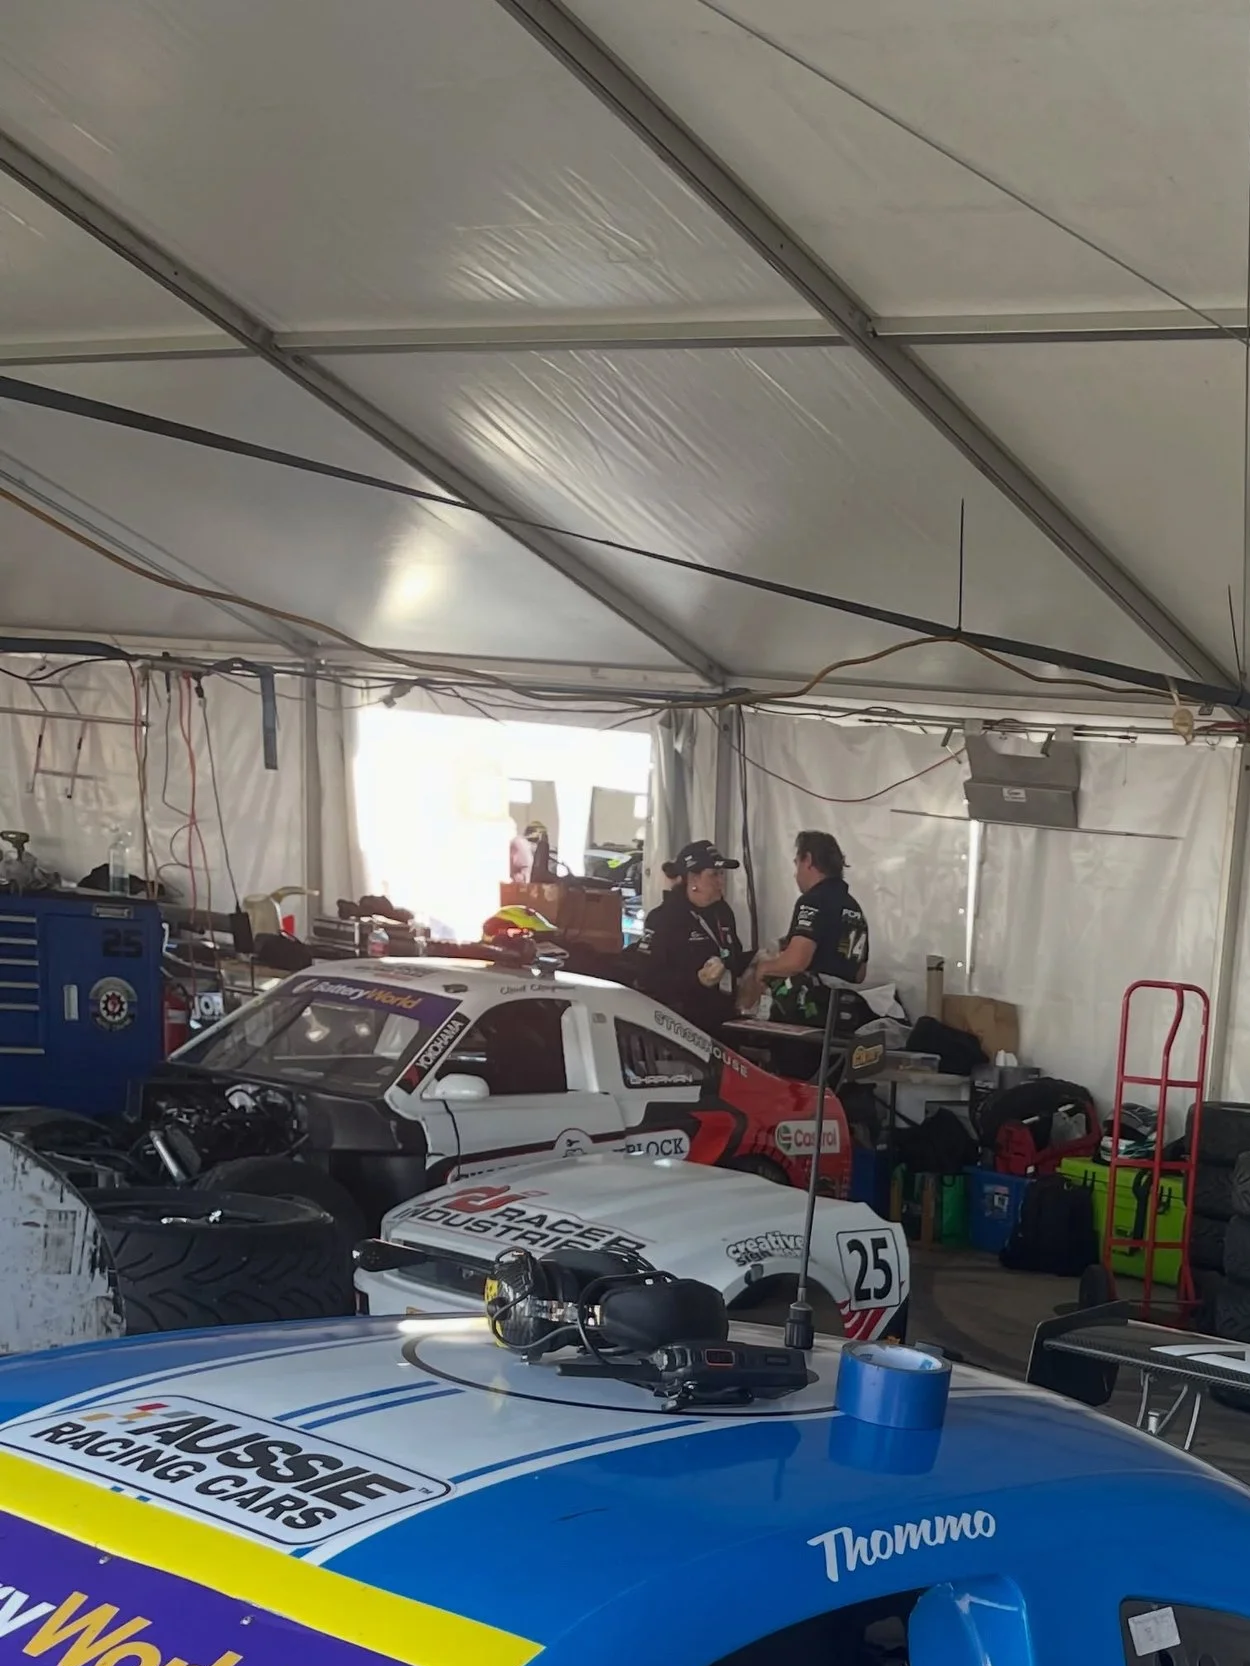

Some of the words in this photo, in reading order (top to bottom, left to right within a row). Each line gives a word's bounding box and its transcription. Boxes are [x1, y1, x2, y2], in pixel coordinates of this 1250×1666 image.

[102, 928, 143, 958] 25
[416, 1019, 463, 1069] YOKOHAMA
[391, 1207, 597, 1250] INDUSTRIE
[847, 1236, 893, 1301] 25
[31, 1421, 198, 1485] RACING
[195, 1474, 338, 1531] CARS
[131, 1415, 416, 1511] AUSSIE
[806, 1510, 996, 1582] Thommo
